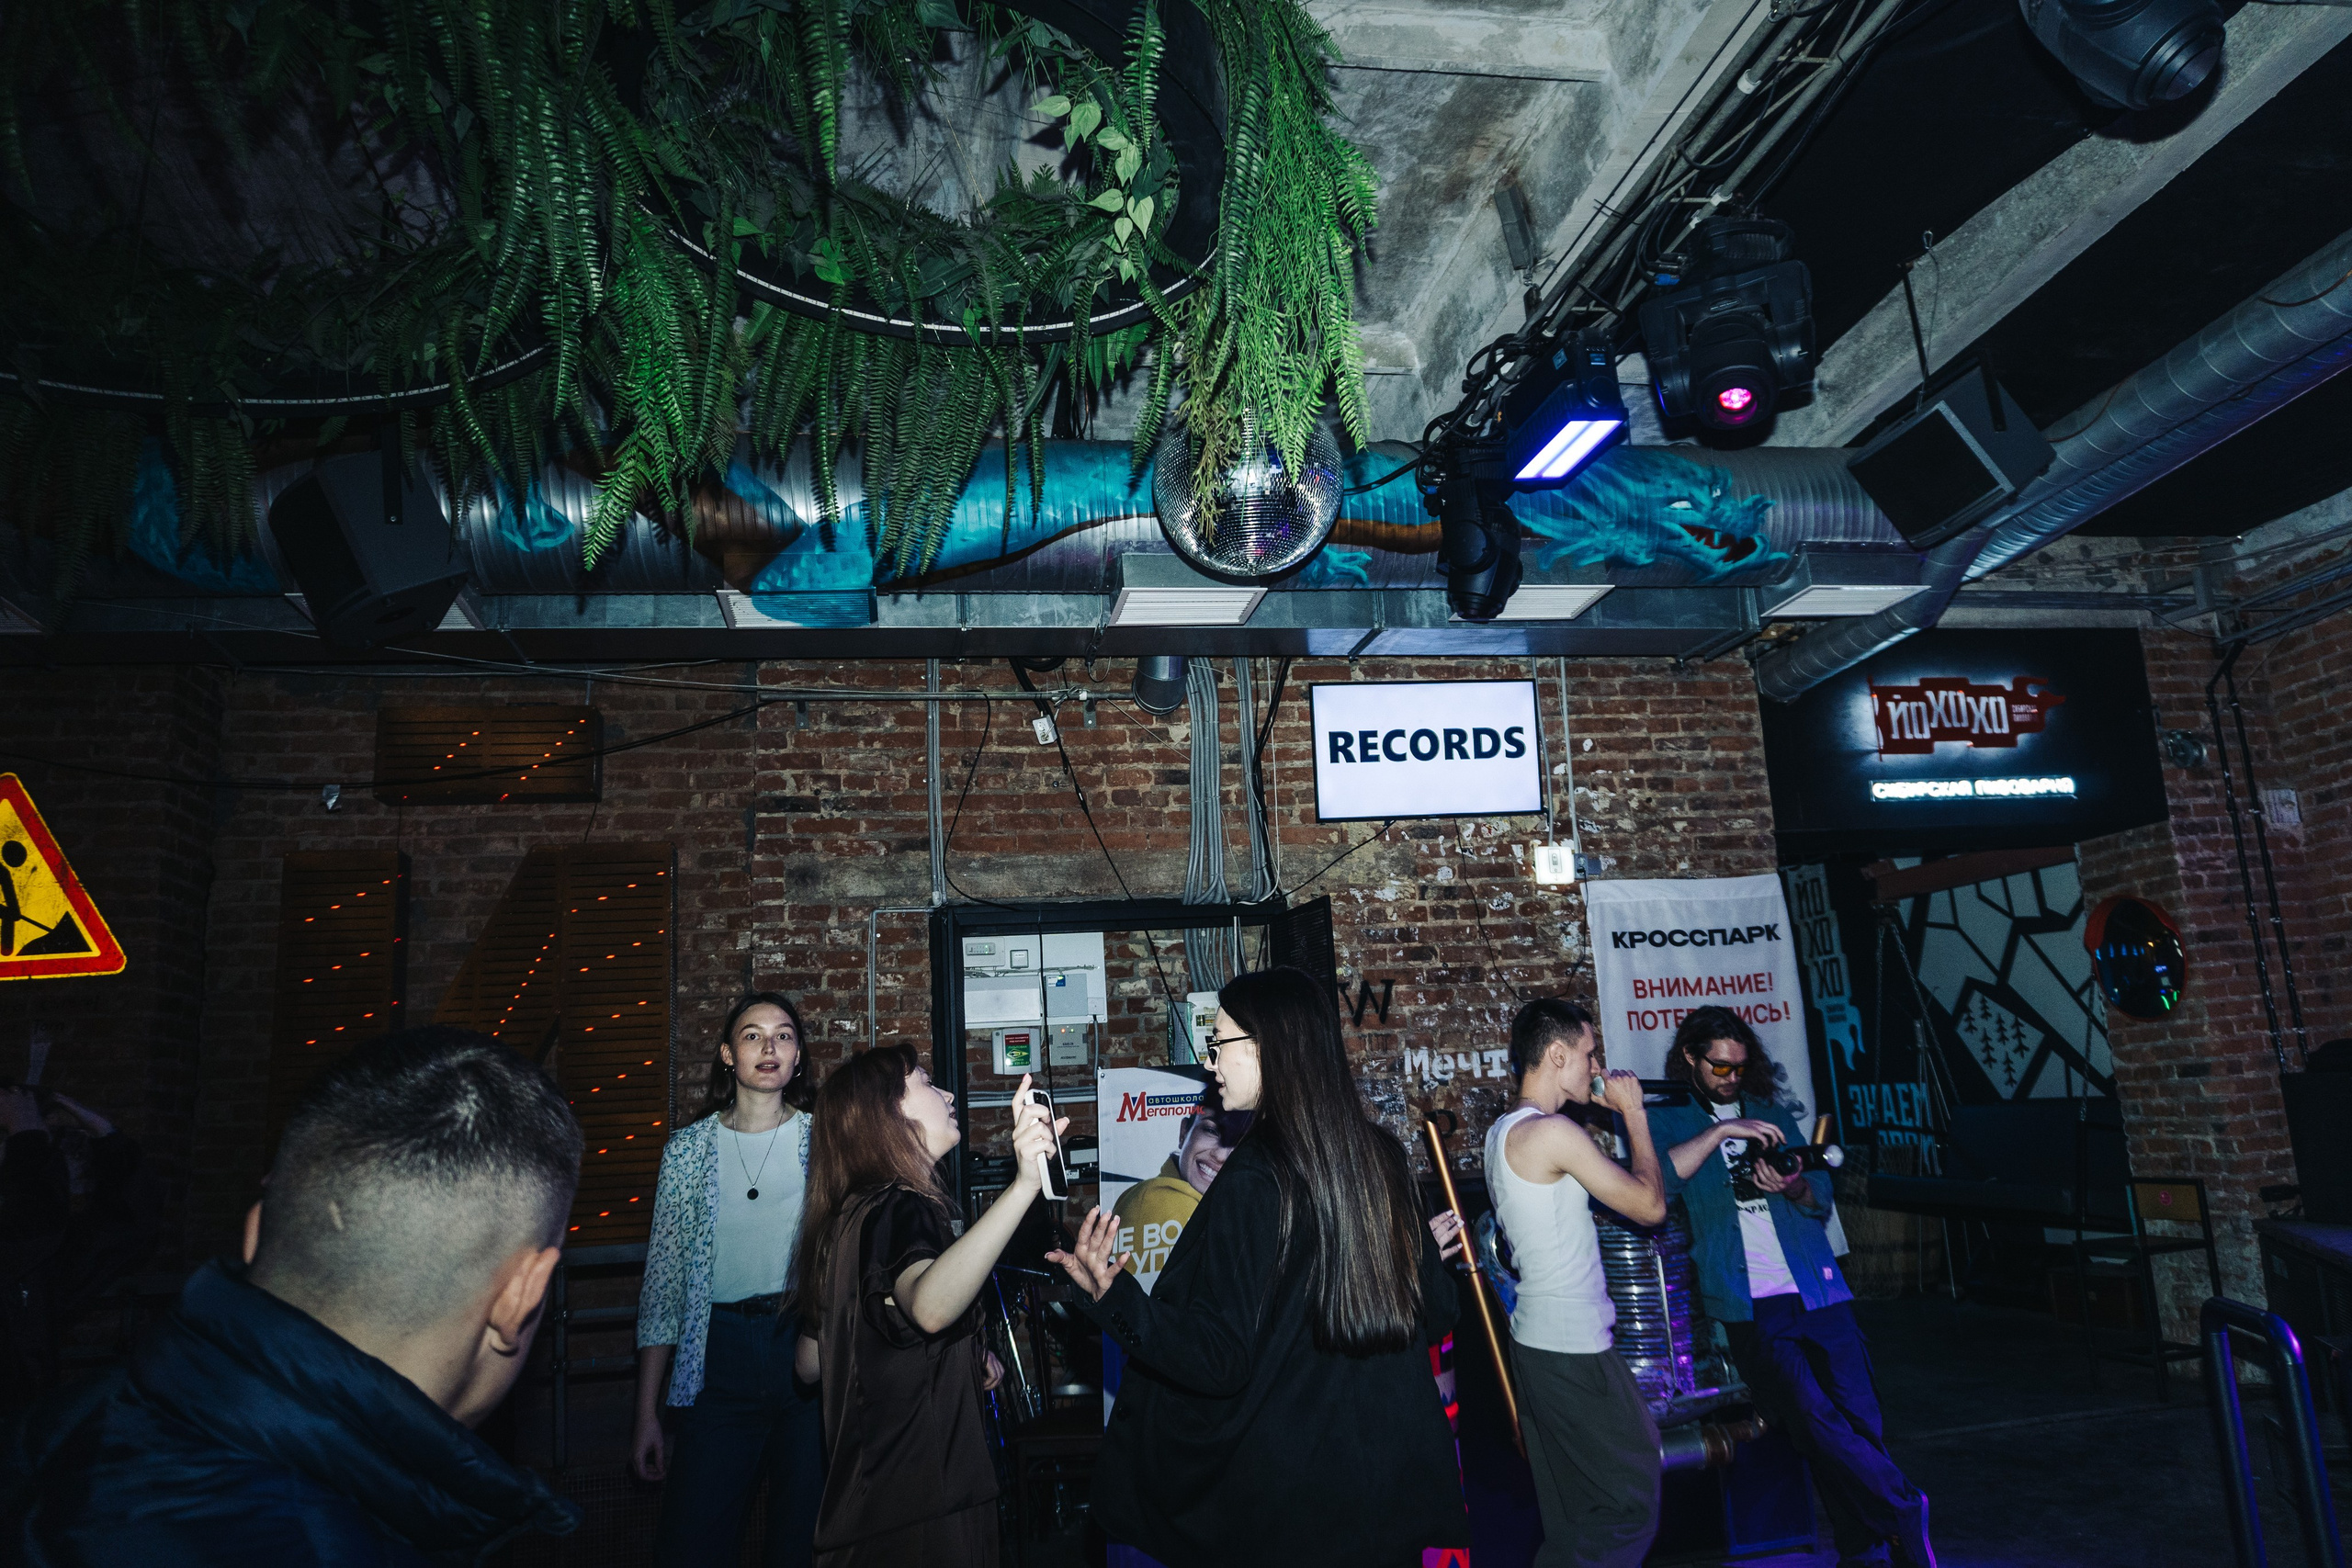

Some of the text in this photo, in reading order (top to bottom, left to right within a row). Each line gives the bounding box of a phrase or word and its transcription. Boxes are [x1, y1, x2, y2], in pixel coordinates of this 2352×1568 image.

[1329, 726, 1526, 764] RECORDS
[1611, 923, 1781, 949] КРОССПАРК
[1633, 972, 1773, 999] ВНИМАНИЕ!
[1116, 1091, 1206, 1122] Мегаполис
[1148, 1094, 1204, 1105] автошкола
[1848, 1082, 1933, 1129] ЗНАЕМ
